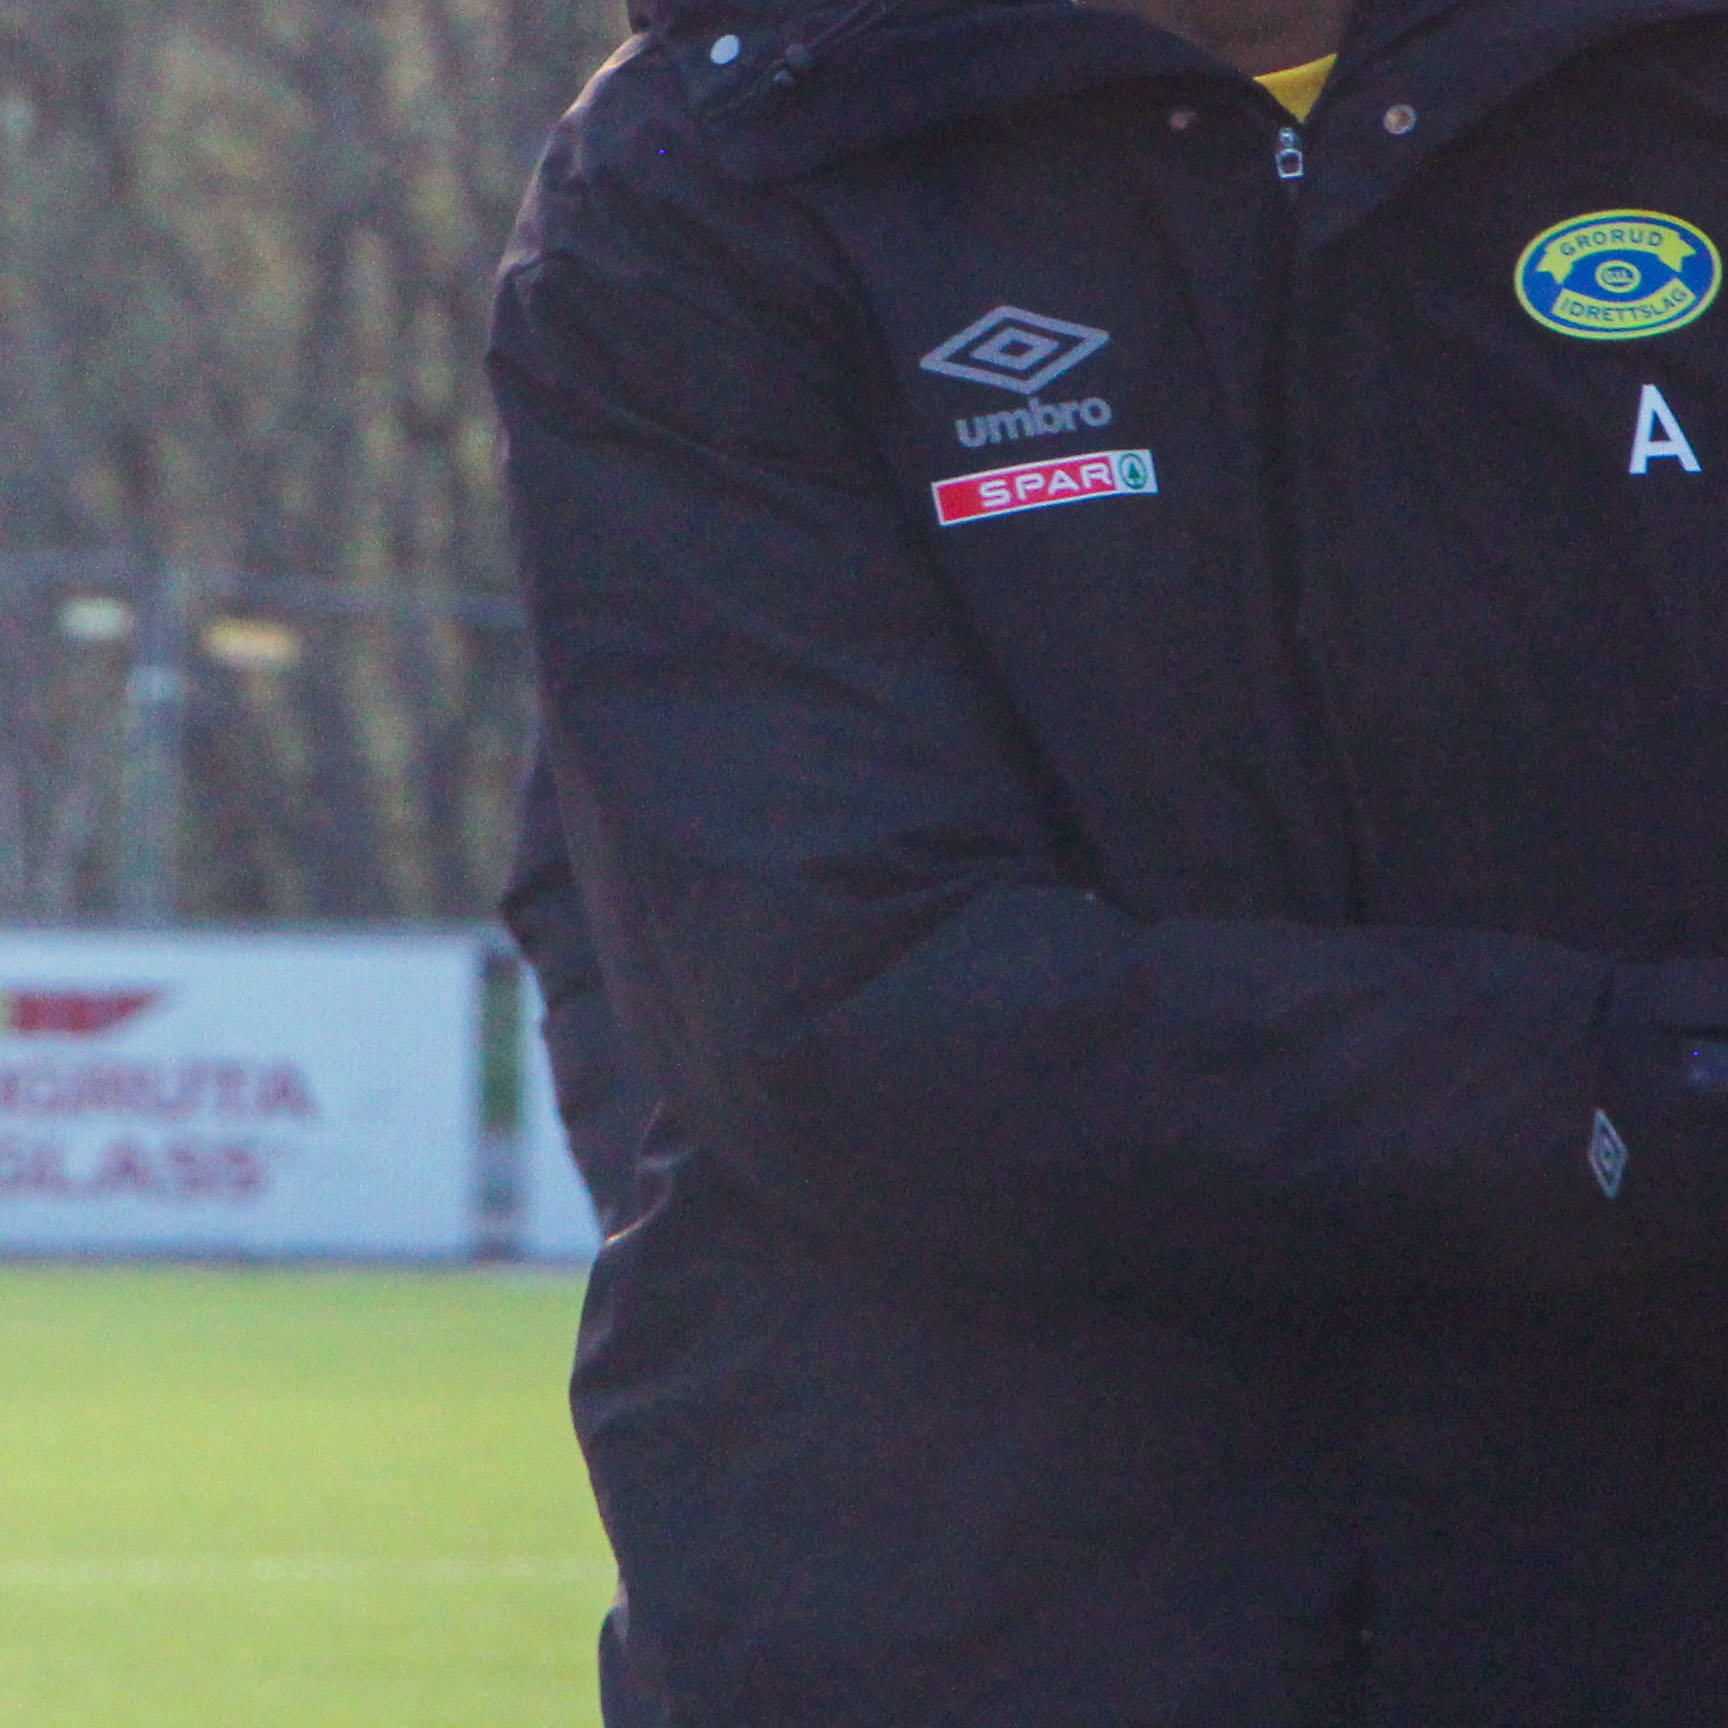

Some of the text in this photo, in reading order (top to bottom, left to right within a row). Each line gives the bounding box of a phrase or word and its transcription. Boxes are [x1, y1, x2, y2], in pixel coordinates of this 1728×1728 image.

[1558, 228, 1664, 257] GRORUD
[1560, 286, 1688, 322] IDRETTSLAG
[954, 395, 1113, 449] umbro
[1628, 382, 1703, 476] A
[978, 460, 1114, 509] SPAR
